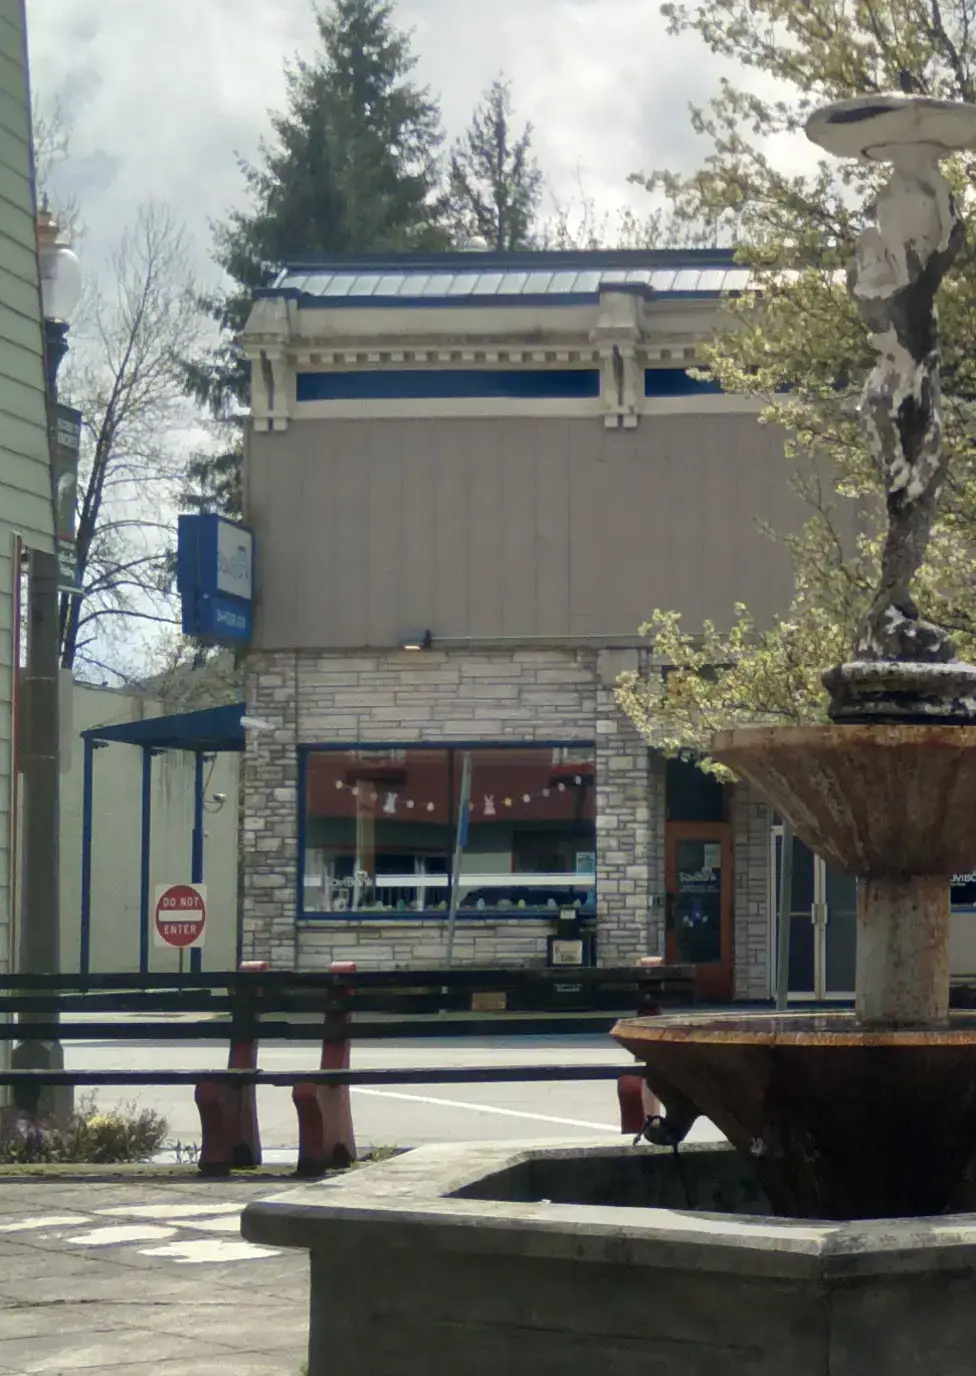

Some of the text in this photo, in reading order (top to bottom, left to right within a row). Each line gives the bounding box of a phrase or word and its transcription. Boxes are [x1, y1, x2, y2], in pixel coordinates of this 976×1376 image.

[163, 896, 199, 907] DO NOT
[164, 924, 196, 934] ENTER
